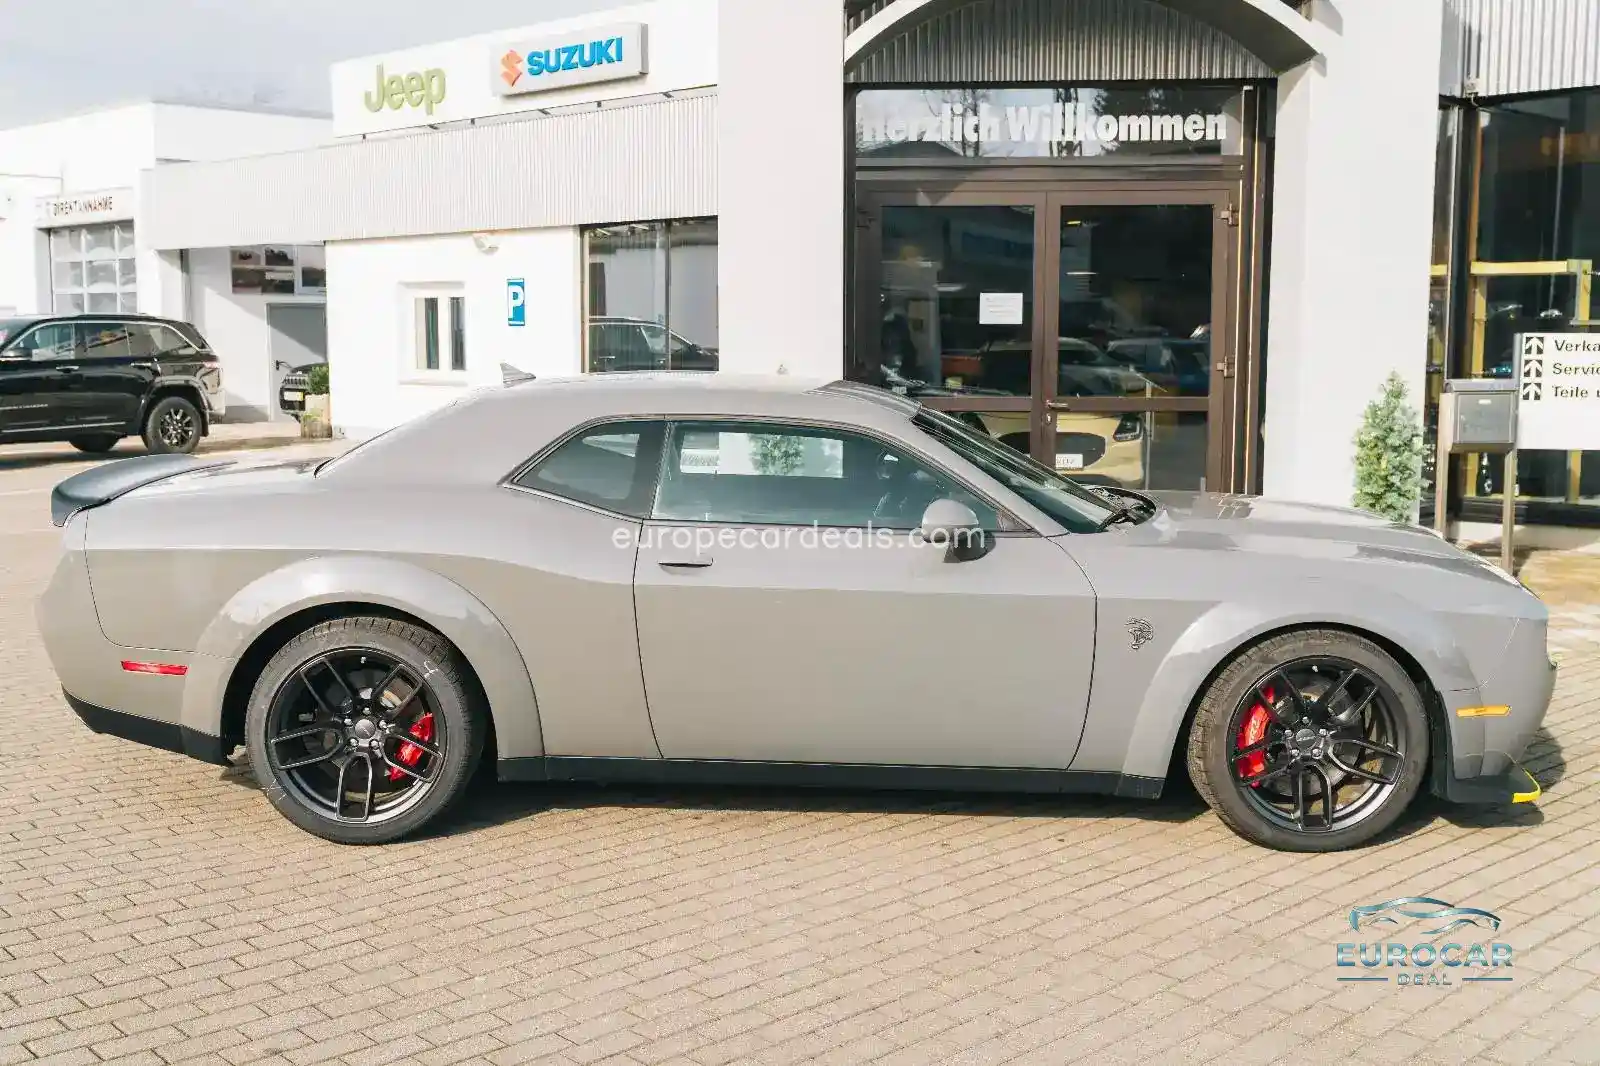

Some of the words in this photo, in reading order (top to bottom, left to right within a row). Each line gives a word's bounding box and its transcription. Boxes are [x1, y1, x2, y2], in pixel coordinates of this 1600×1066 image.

[526, 36, 624, 77] SUZUKI
[364, 63, 447, 117] Jeep
[1006, 102, 1227, 142] Willkommen
[508, 284, 524, 319] P
[1552, 385, 1589, 398] Teile
